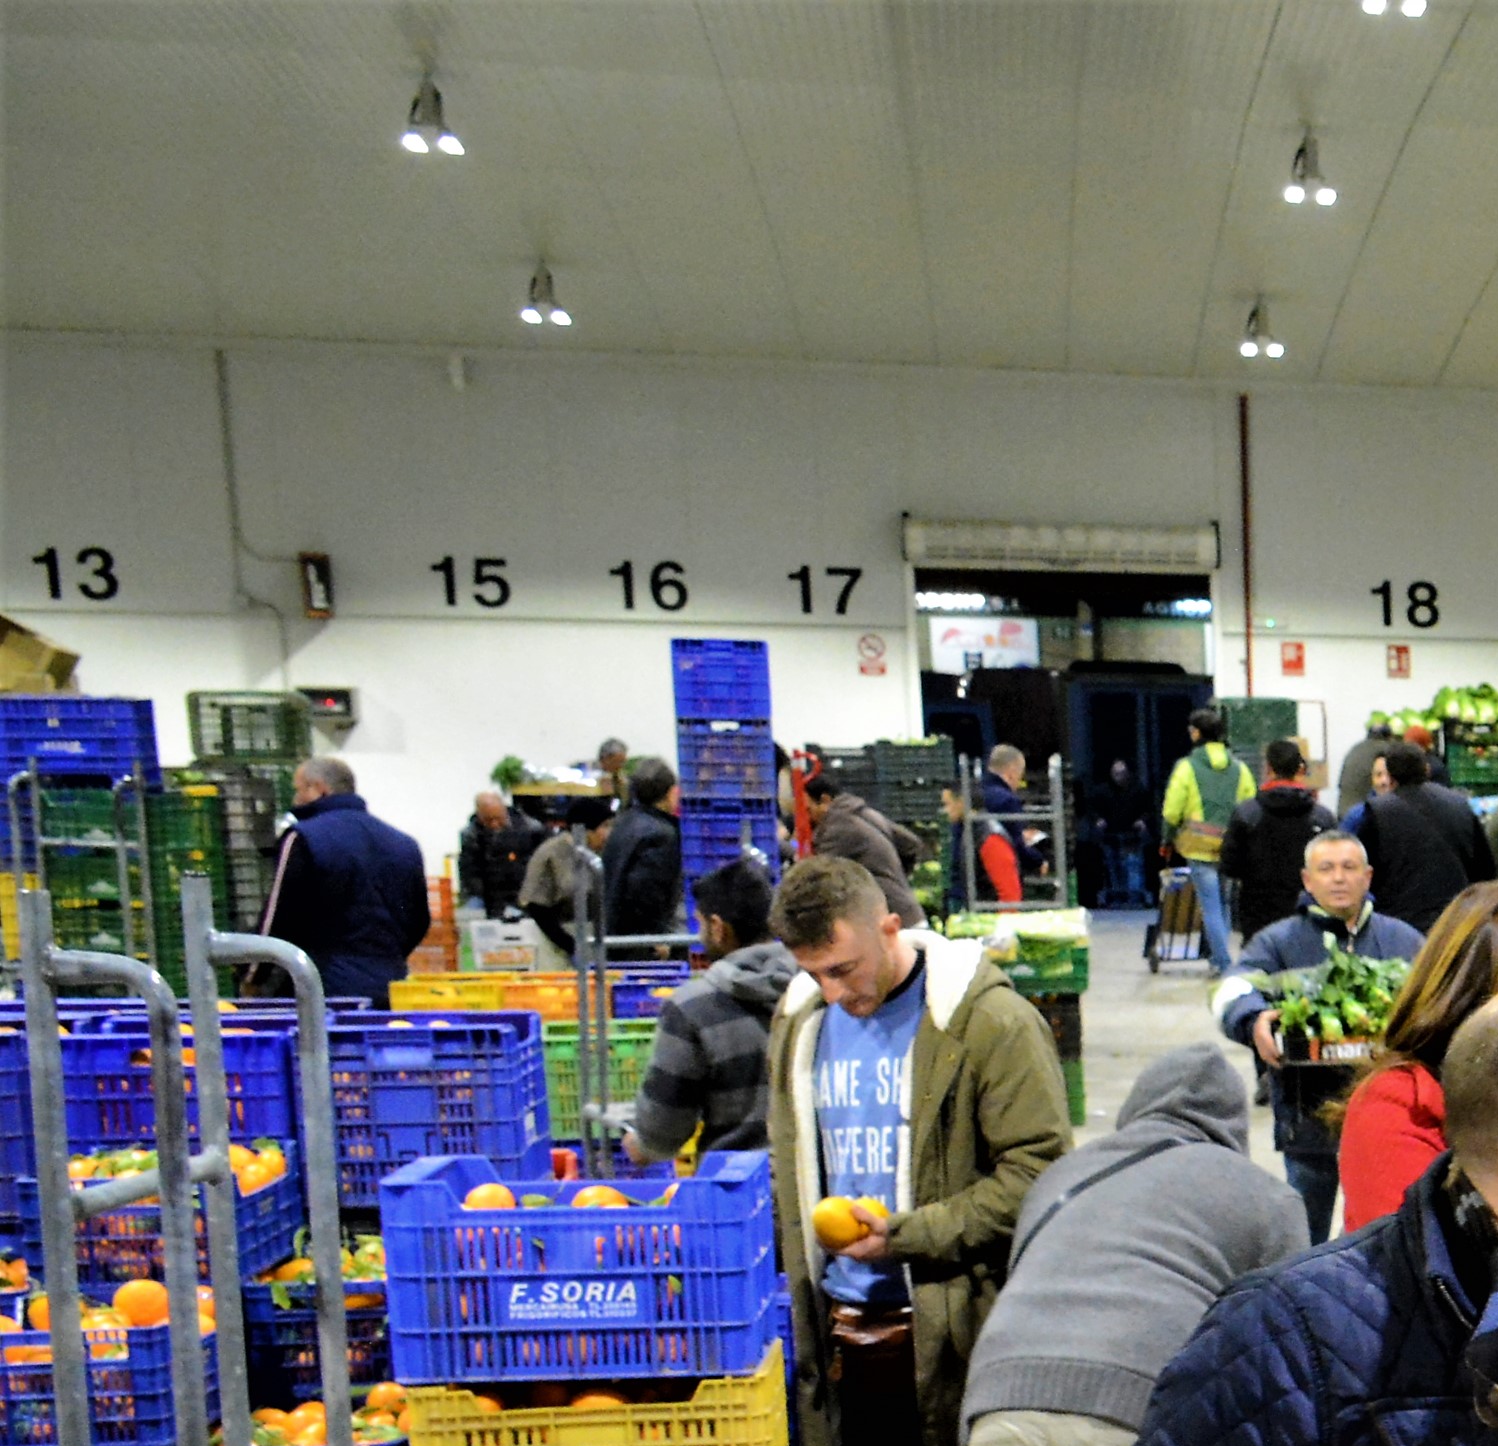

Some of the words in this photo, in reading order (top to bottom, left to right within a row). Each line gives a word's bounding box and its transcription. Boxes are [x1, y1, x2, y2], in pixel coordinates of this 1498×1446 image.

[33, 547, 118, 600] 13
[431, 556, 510, 607] 15
[610, 561, 687, 610] 16
[788, 566, 862, 614] 17
[1372, 580, 1439, 628] 18
[816, 1060, 862, 1108] AME
